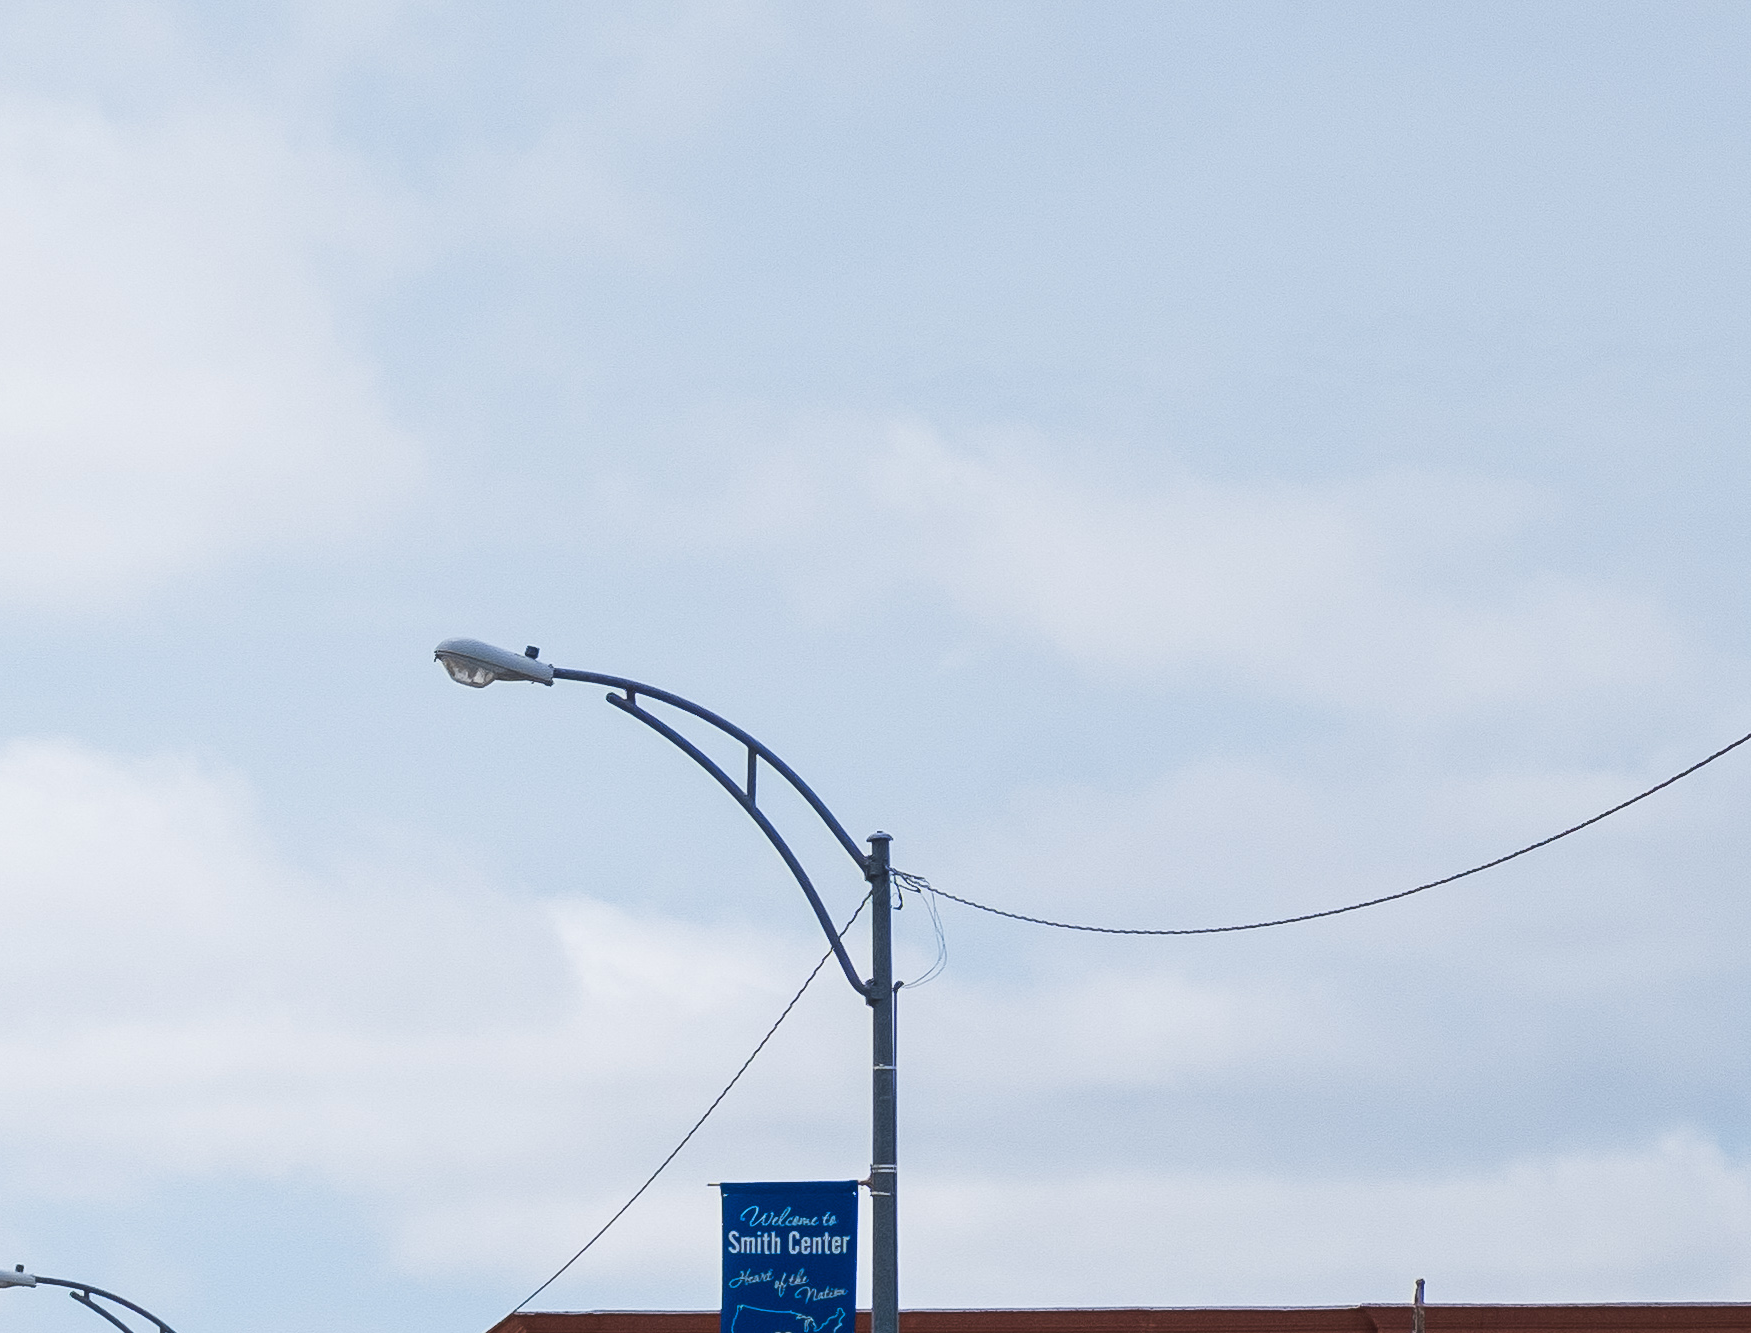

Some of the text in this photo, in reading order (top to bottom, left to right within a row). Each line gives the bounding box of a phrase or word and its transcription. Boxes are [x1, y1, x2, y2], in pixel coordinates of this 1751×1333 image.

[740, 1205, 837, 1227] Welcome to
[728, 1230, 850, 1254] Smith Center
[728, 1268, 809, 1298] Heart of the
[795, 1286, 849, 1304] Nation
